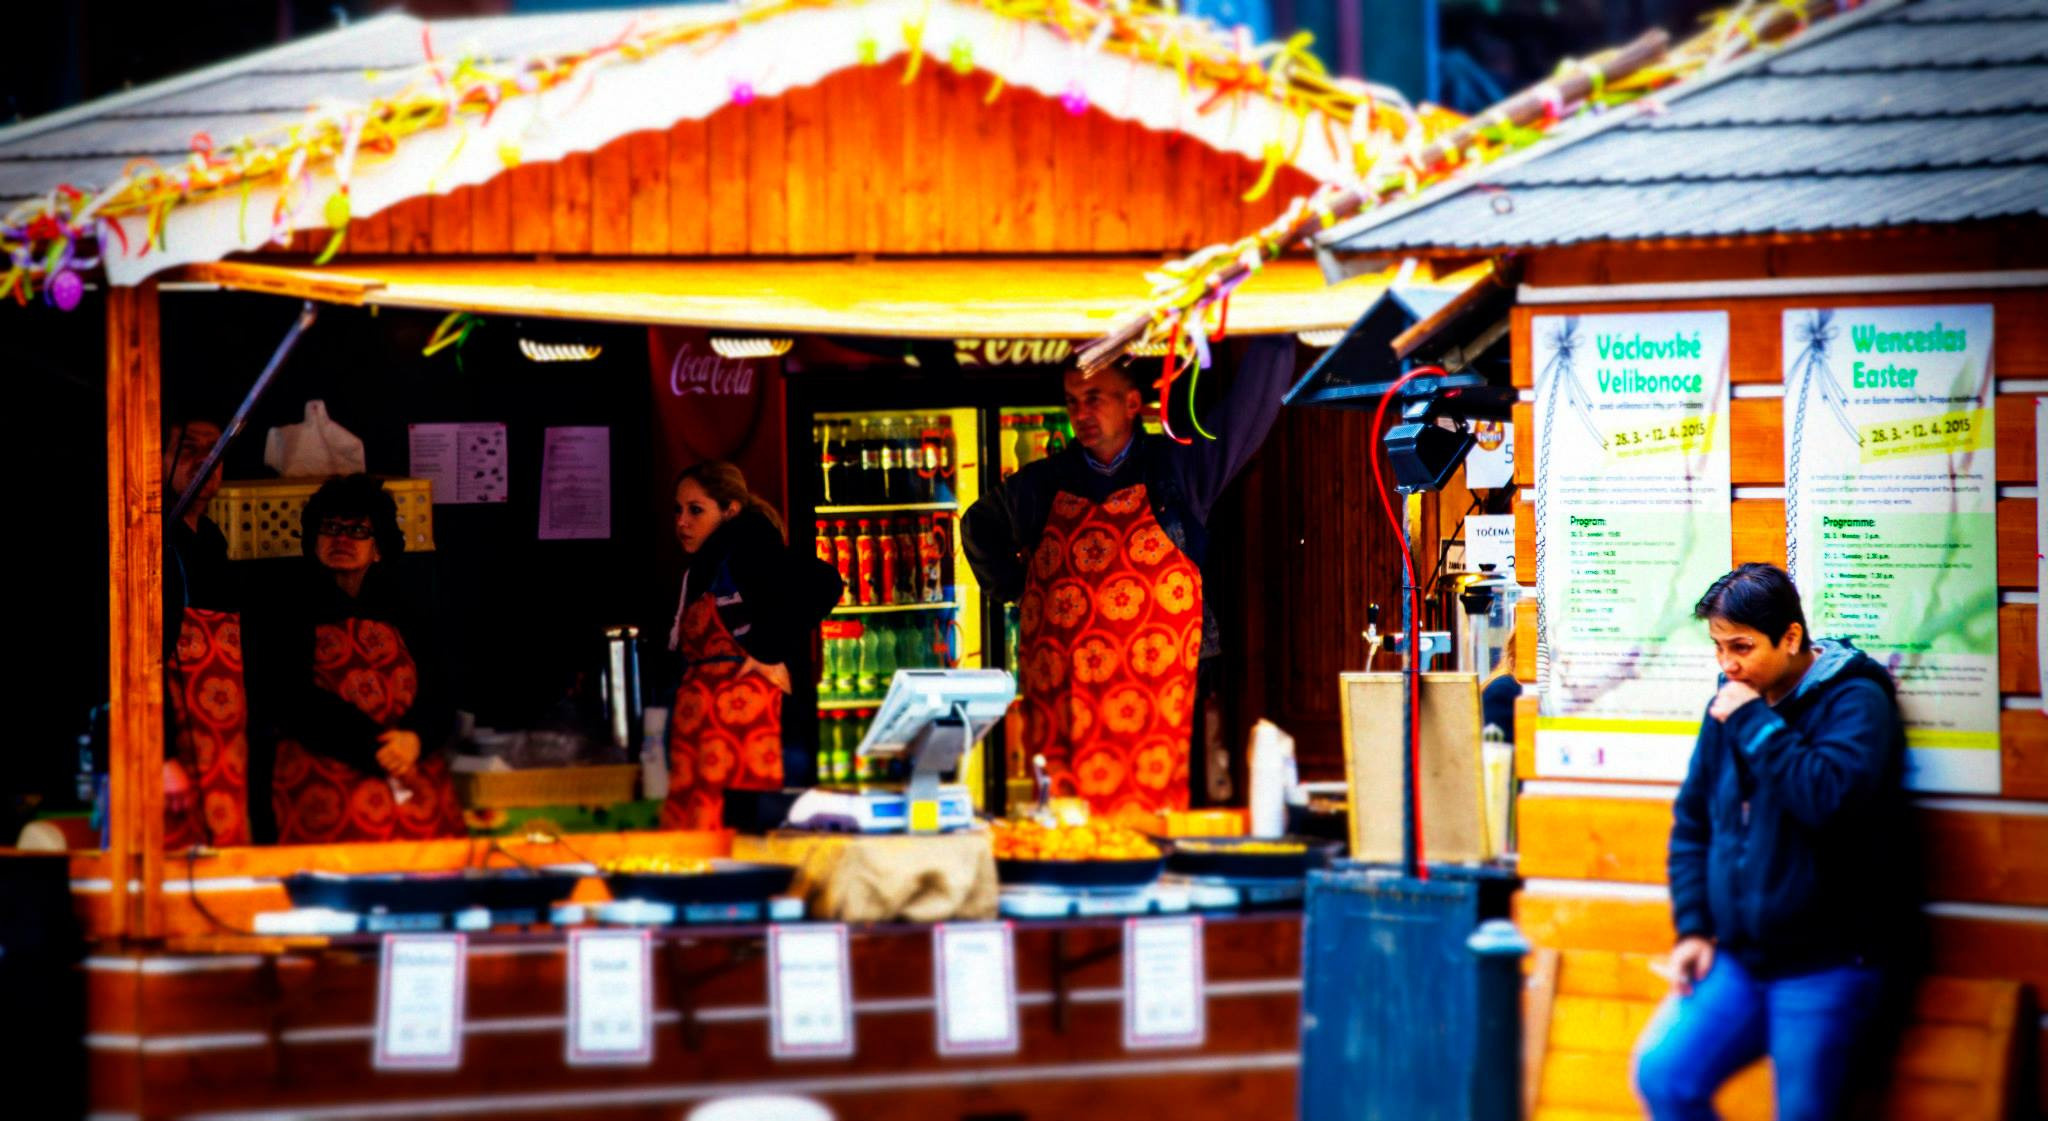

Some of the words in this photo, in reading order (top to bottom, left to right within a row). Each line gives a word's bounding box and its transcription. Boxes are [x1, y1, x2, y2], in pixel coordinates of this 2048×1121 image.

[1851, 321, 1966, 353] Wenceslas
[1596, 331, 1702, 360] Václavské
[1597, 367, 1702, 394] Velikonoce
[1852, 361, 1918, 389] Easter
[1682, 422, 1705, 437] 2015
[1945, 418, 1971, 434] 2015
[1570, 515, 1607, 528] Program:
[1823, 516, 1876, 529] Programme:
[1476, 525, 1510, 537] TOČENÁ
